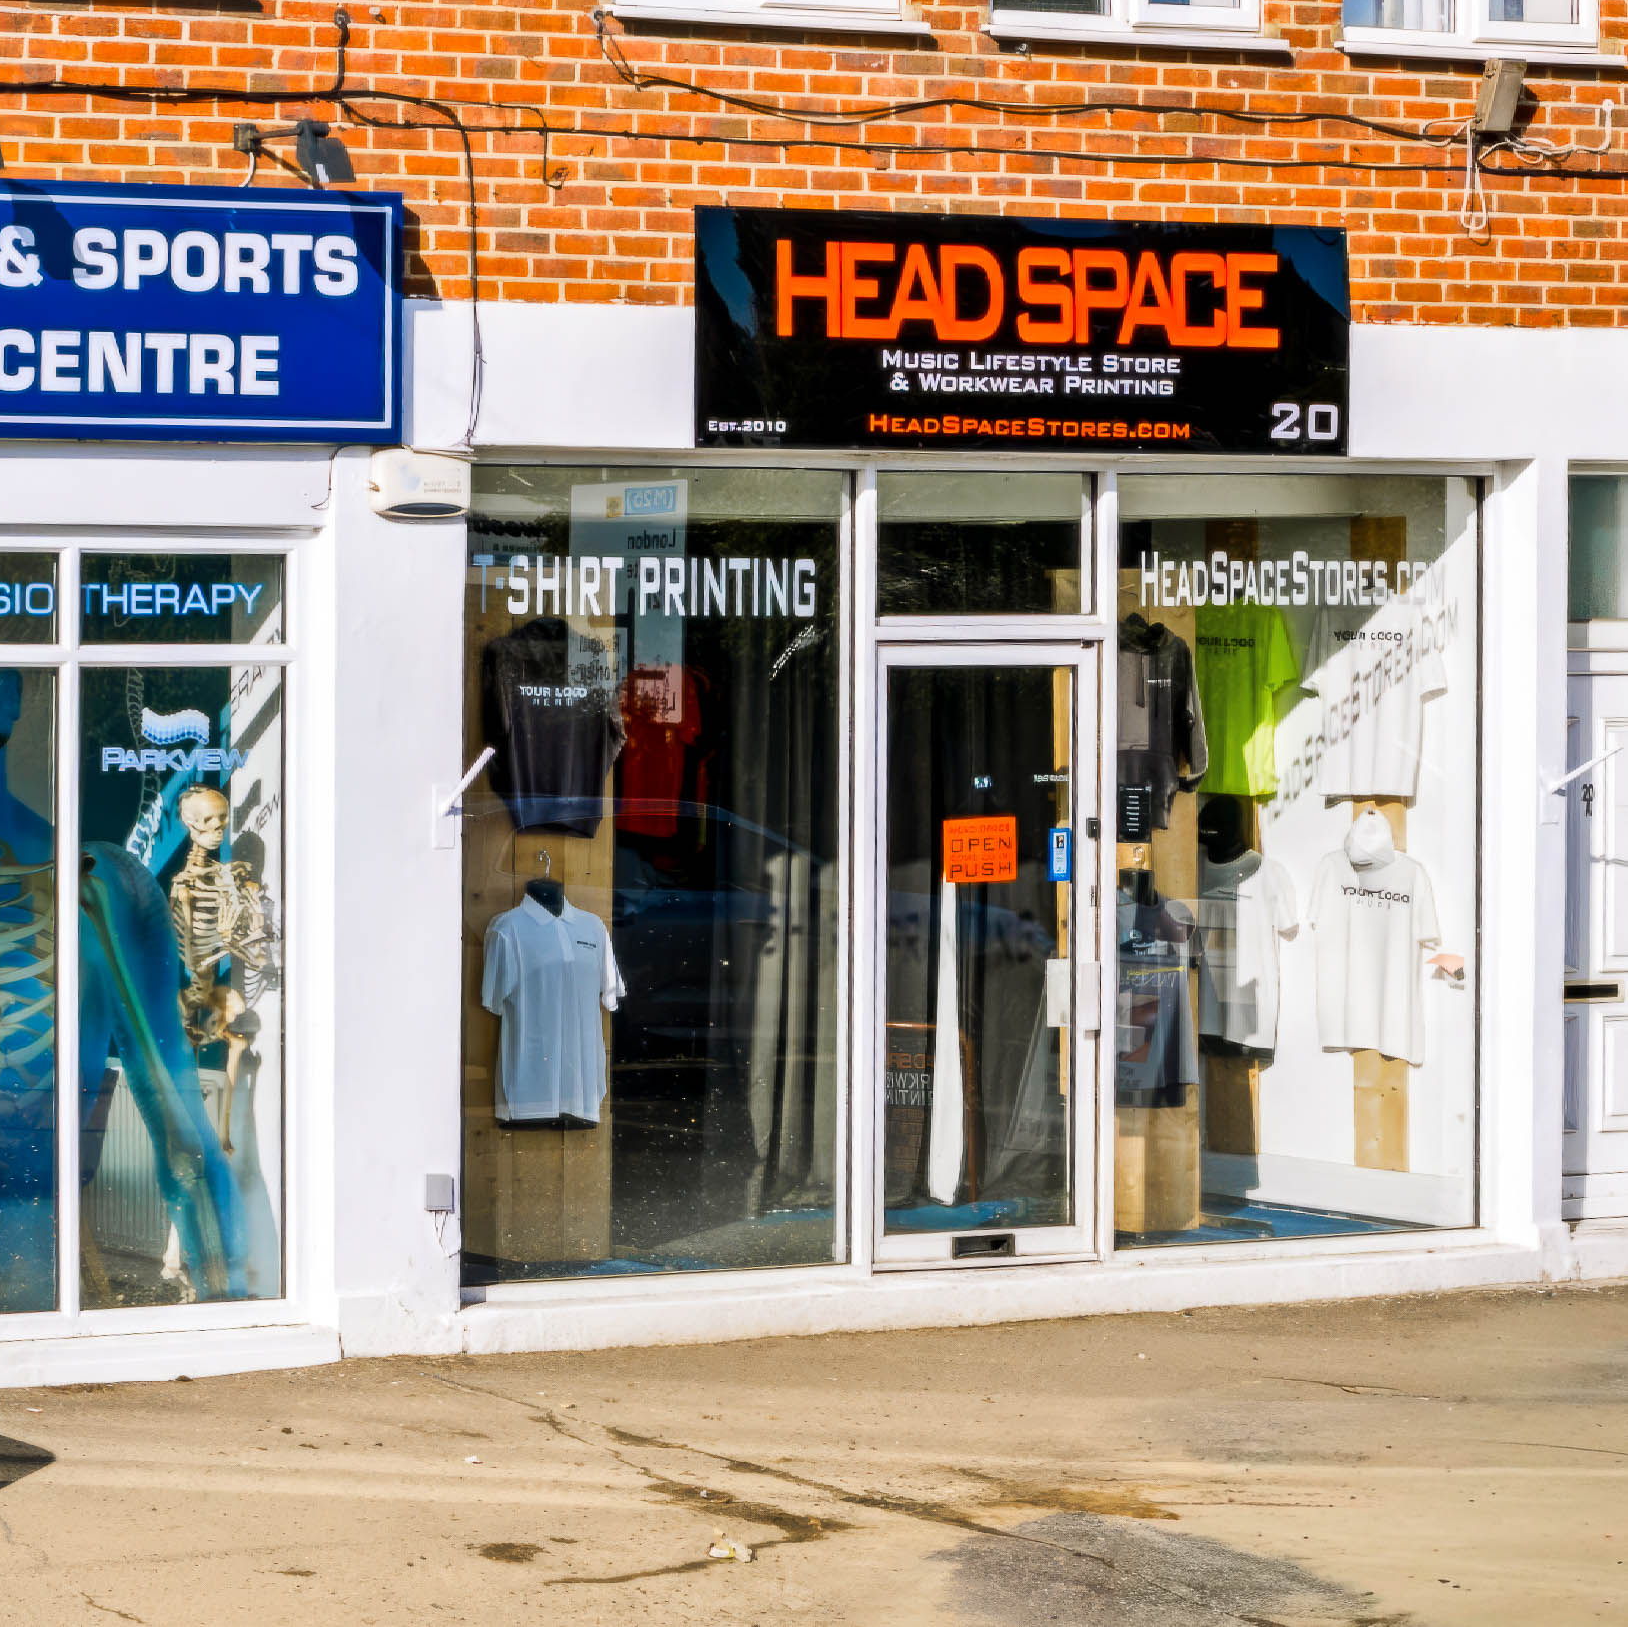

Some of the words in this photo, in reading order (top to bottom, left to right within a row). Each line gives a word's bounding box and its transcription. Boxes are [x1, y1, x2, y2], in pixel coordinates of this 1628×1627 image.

[72, 228, 359, 297] SPORTS
[890, 373, 910, 392] &
[1270, 402, 1340, 441] 20
[472, 554, 625, 617] T-SHIRT
[639, 556, 817, 618] PRINTING
[101, 746, 252, 773] PARKVIEW
[951, 837, 1013, 853] OPEN
[950, 861, 1011, 879] PUSH
